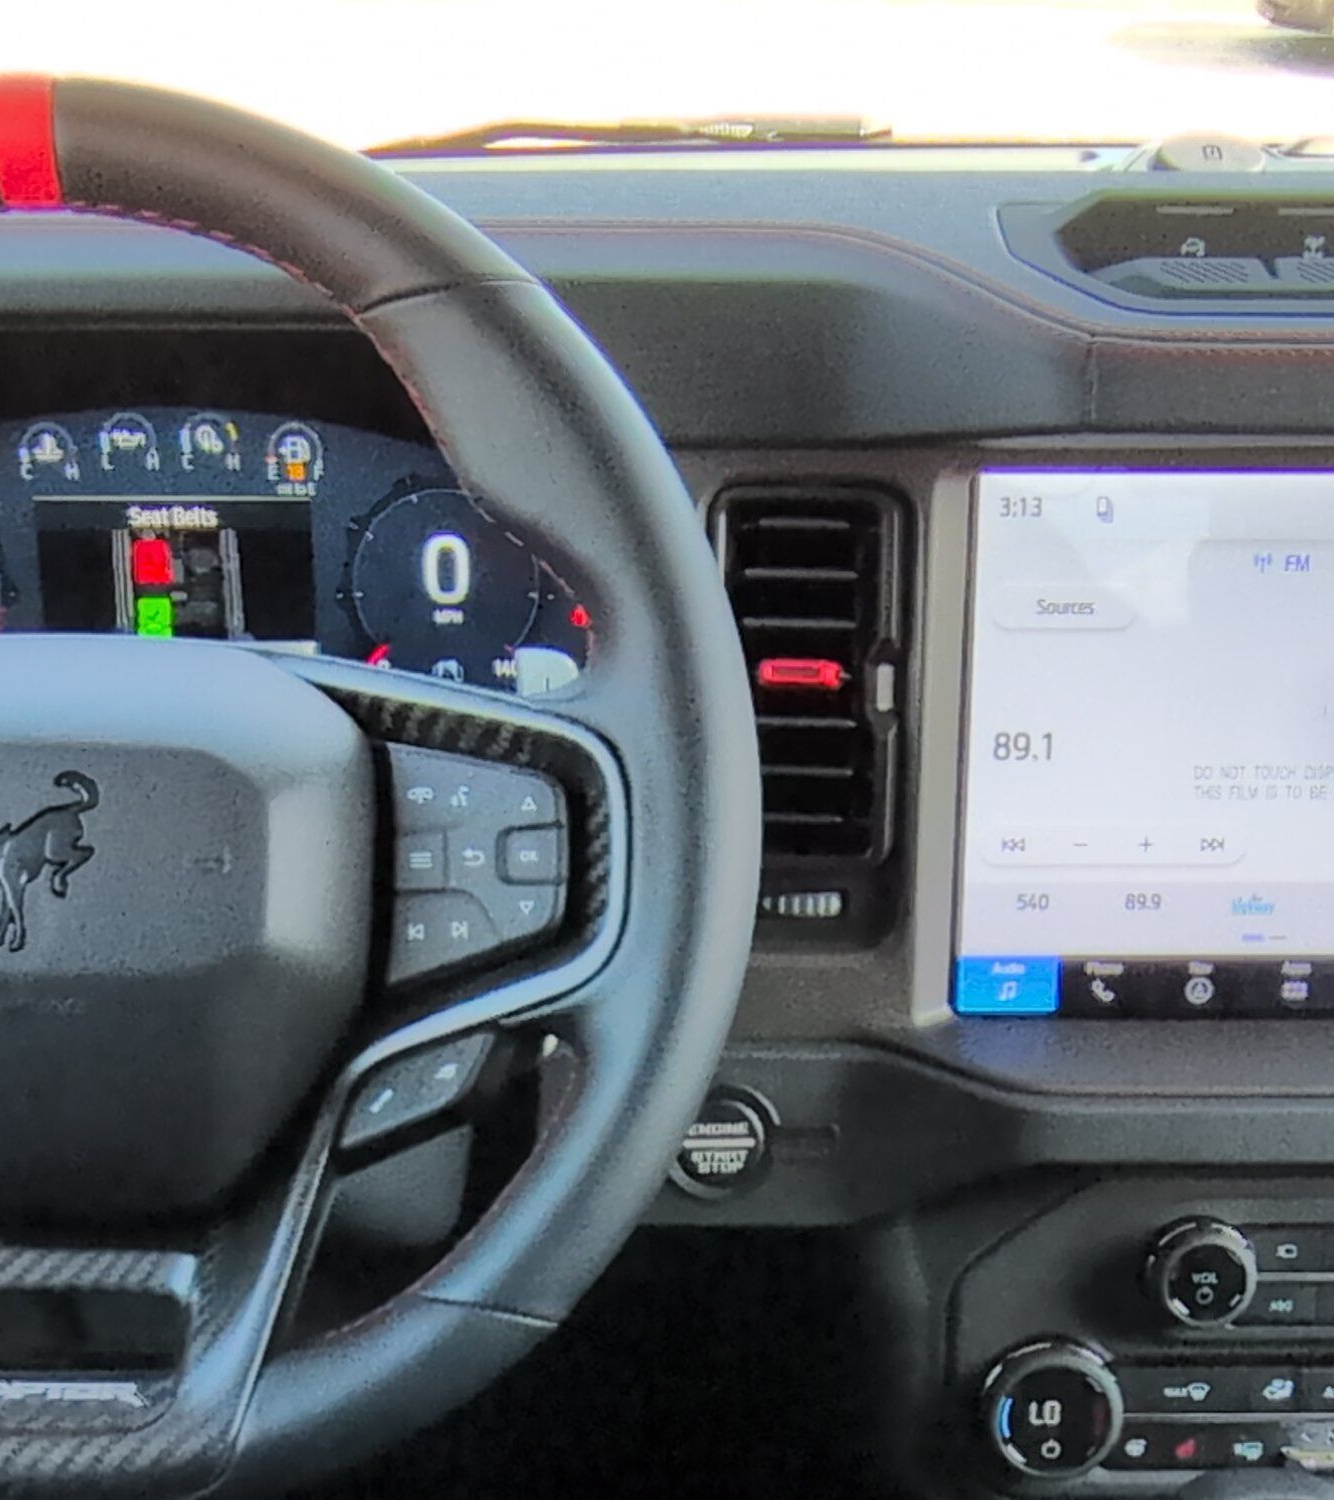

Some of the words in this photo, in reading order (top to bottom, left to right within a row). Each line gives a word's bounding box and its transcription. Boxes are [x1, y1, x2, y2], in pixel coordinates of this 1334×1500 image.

[999, 496, 1043, 518] 3:13
[127, 505, 169, 528] Seat
[170, 505, 218, 528] Belts
[422, 530, 470, 604] 0
[1283, 554, 1311, 573] FM
[1035, 599, 1095, 616] Sources
[993, 732, 1054, 761] 89.1
[1193, 765, 1213, 780] DO
[1220, 765, 1246, 780] NOT
[1254, 765, 1296, 780] TOUCH
[1194, 785, 1222, 800] THIS
[1285, 785, 1303, 800] TO
[1015, 893, 1050, 911] 540
[1124, 893, 1162, 911] 89.9
[1192, 1271, 1219, 1285] VOL
[1028, 1400, 1063, 1427] LO
